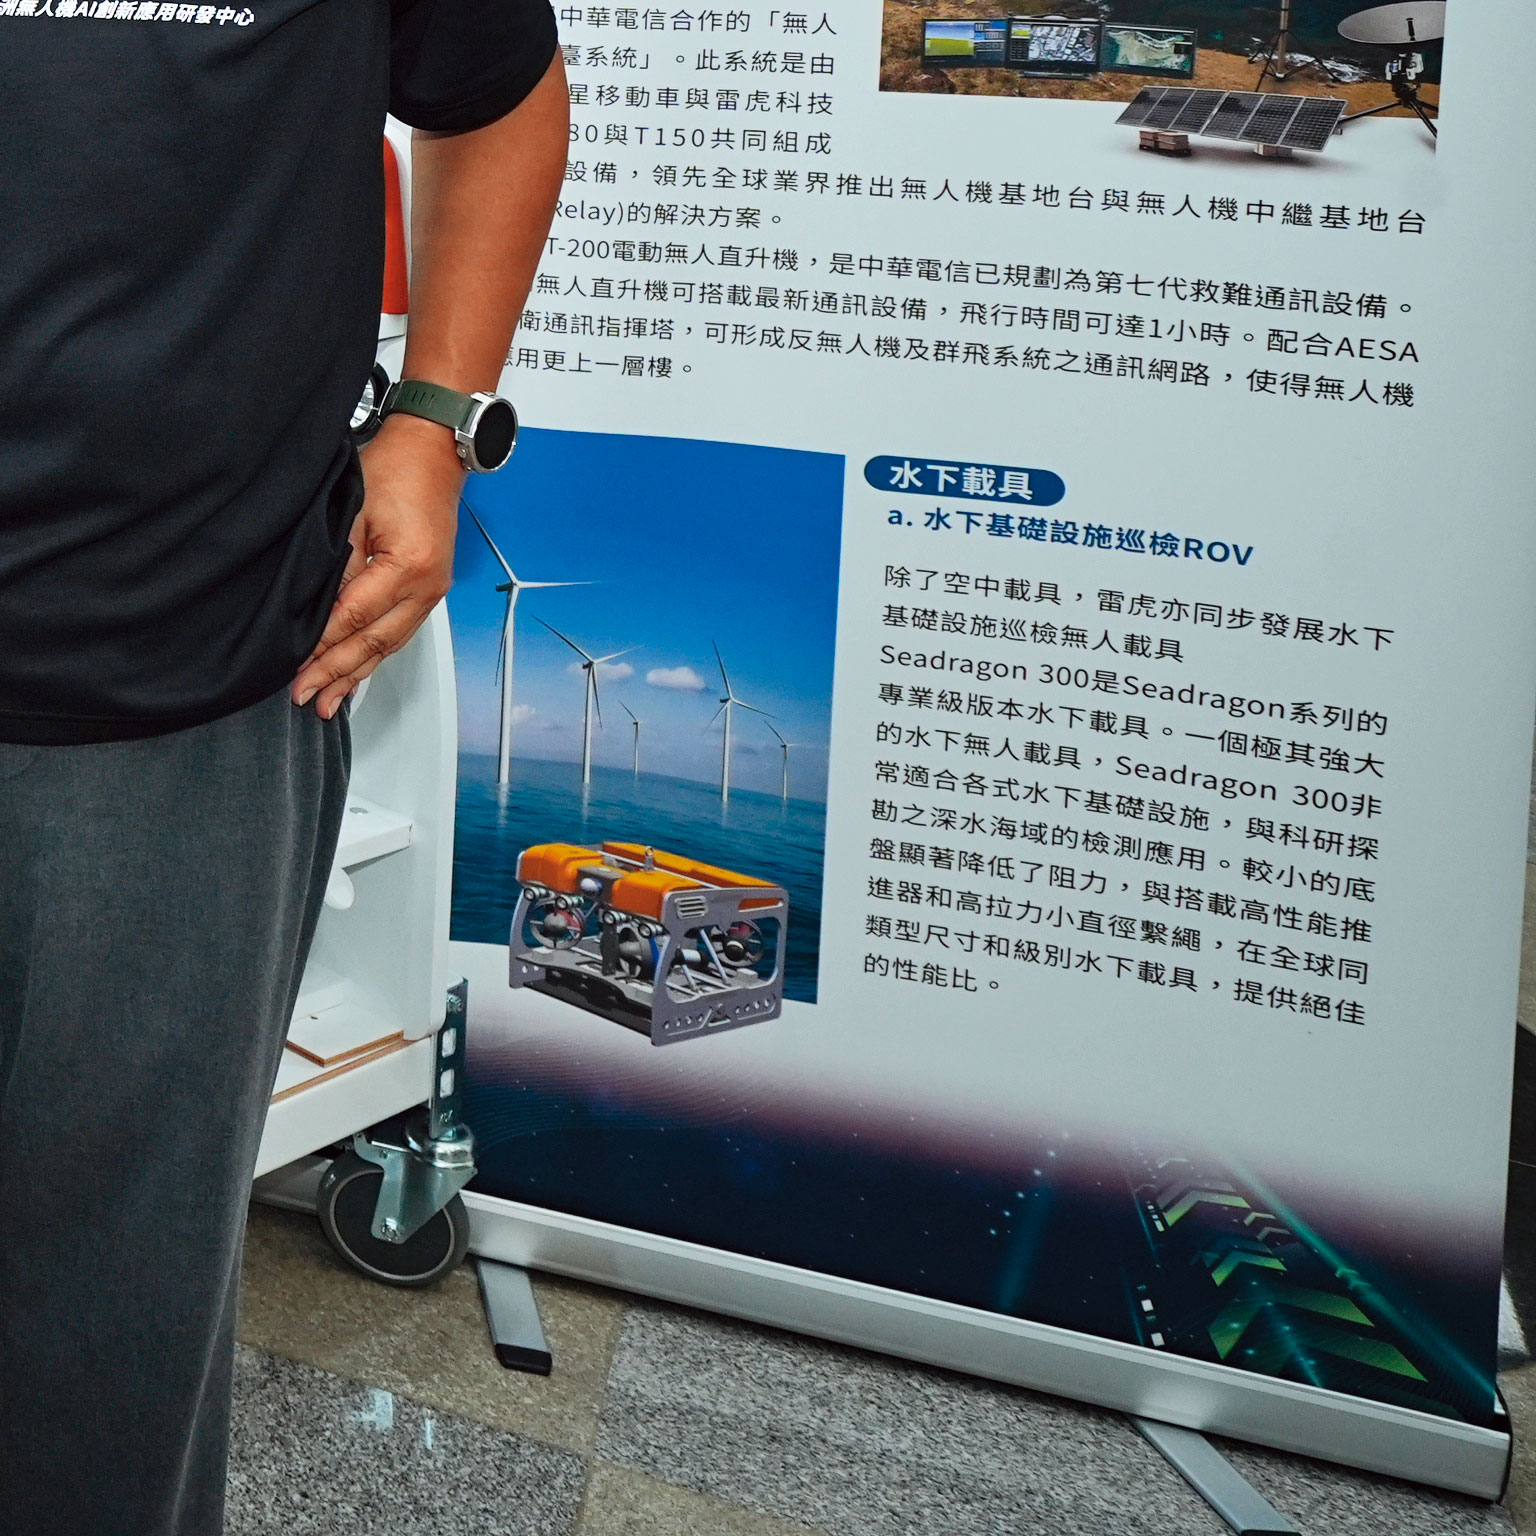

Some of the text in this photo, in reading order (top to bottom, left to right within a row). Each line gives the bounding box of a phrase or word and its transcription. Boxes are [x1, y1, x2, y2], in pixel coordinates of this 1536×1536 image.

[550, 5, 838, 37] 中華電信合作的「無人
[569, 82, 834, 115] 星移動車與雷虎科技
[530, 272, 1421, 364] 無人直升機可搭載最新通訊設備，飛行時間可達1小時。配合AESA
[888, 460, 1034, 501] 水下載具
[887, 507, 1254, 567] a. 水下基礎設施巡檢ROV
[881, 604, 1185, 663] 基礎設施巡檢無人載具
[884, 565, 1395, 651] 除了空中載具，雷虎亦同步發展水下
[877, 683, 1386, 779] 專業級版本水下載具。一個極其強大
[880, 644, 1389, 736] Seadragon 300是Seadragon系列的
[874, 760, 1380, 862] 常適合各式水下基礎設施，與科研探
[876, 720, 1384, 820] 的水下無人載具，Seadragon 300非
[869, 837, 1373, 943] 盤顯著降低了阻力，與搭載高性能推
[871, 798, 1377, 903] 勘之深水海域的檢測應用。較小的底
[863, 952, 1002, 994] 的性能比。
[865, 914, 1366, 1026] 類型尺寸和級別水下載具，提供絕佳
[867, 875, 1369, 985] 進器和高拉力小直徑繫繩，在全球同
